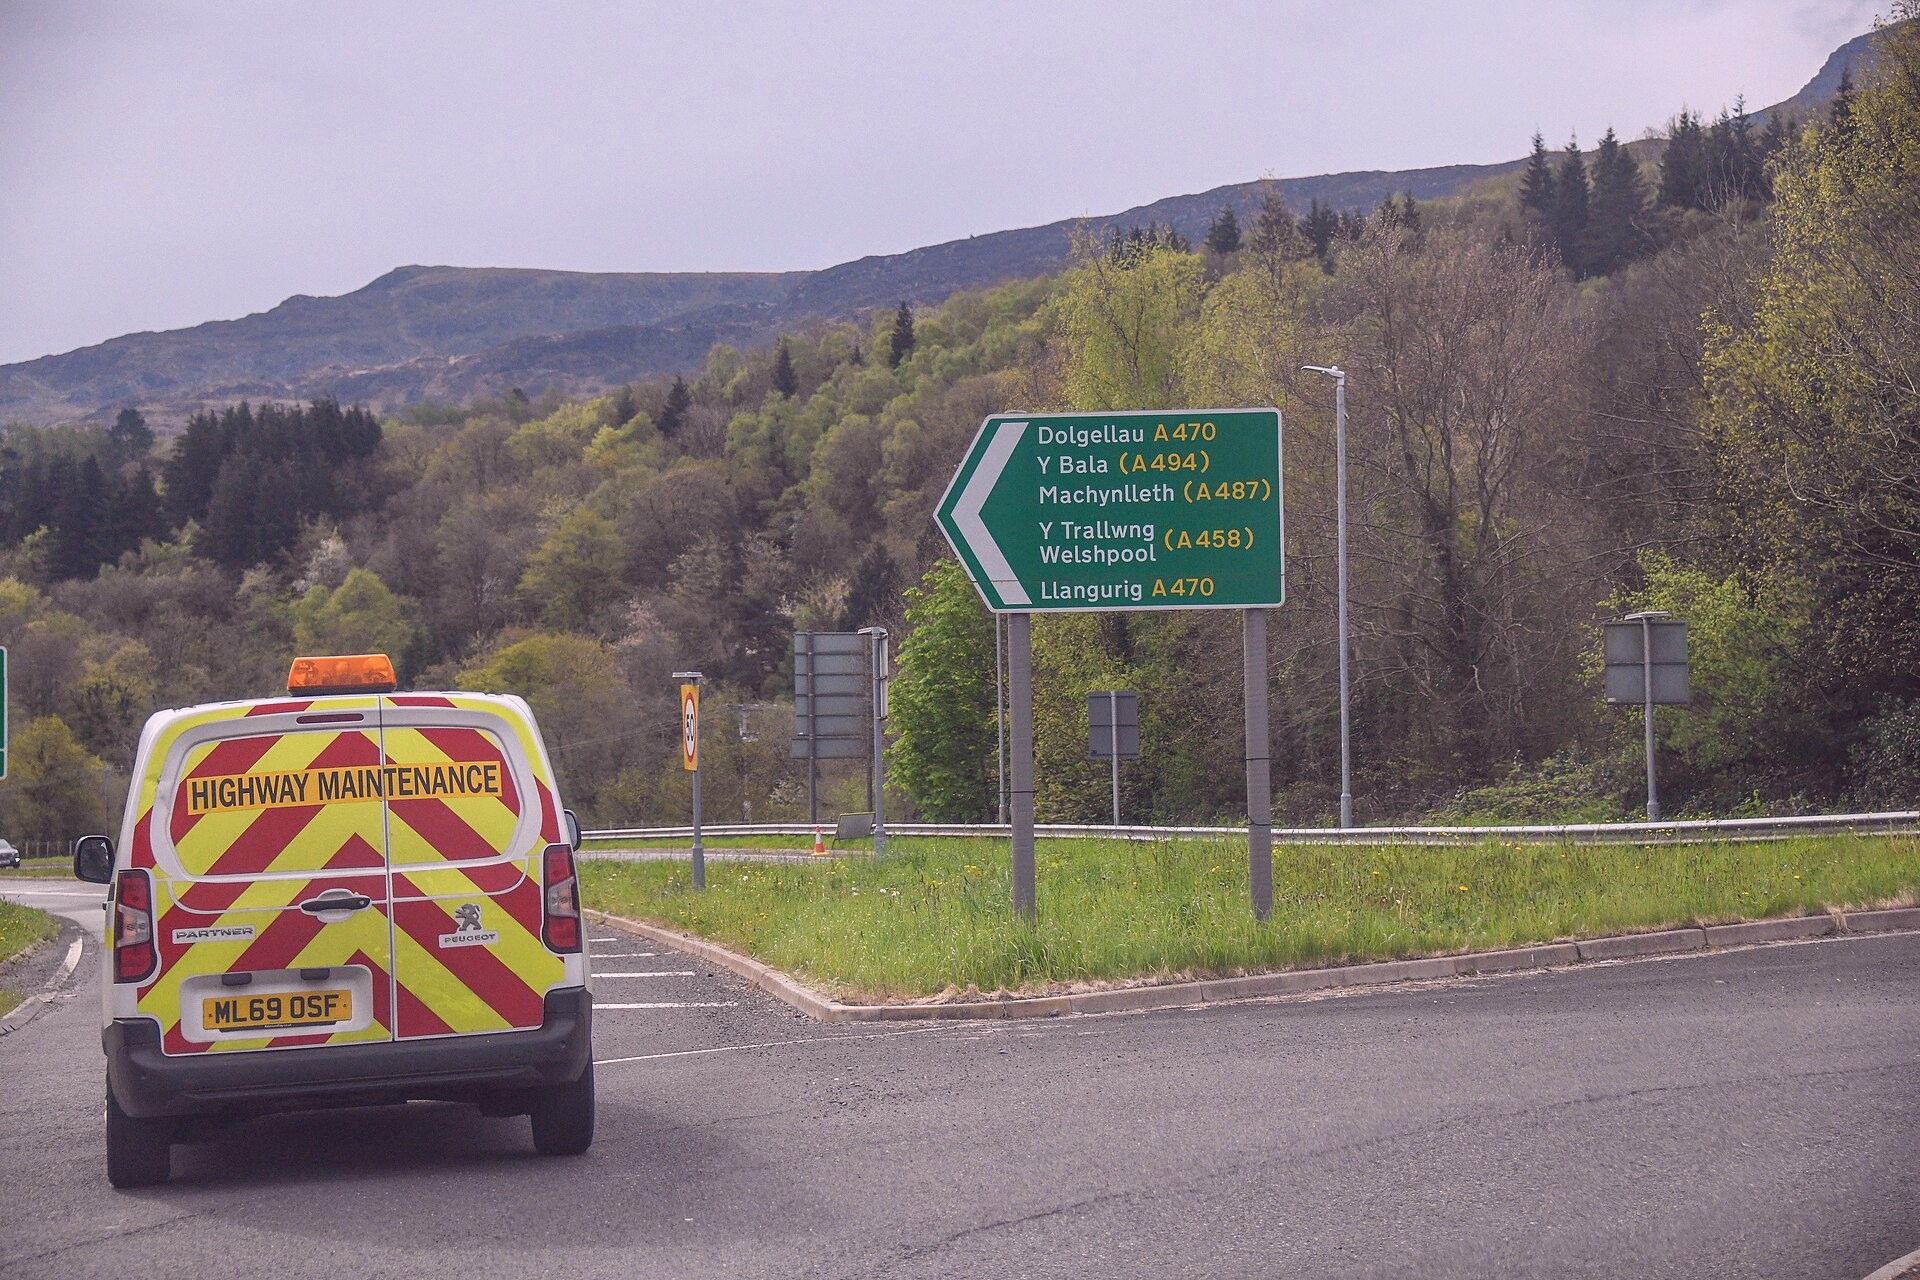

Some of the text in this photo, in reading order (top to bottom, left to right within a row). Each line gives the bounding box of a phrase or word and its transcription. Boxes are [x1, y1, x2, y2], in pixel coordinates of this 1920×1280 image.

[1038, 422, 1217, 447] Dolgellau A470
[1036, 451, 1210, 475] Y Bala (A494)
[1039, 479, 1271, 507] Machynlleth (A487)
[1038, 520, 1155, 542] Y Trallwng
[1164, 527, 1254, 552] (A458)
[1039, 544, 1157, 566] Welshpool
[1041, 577, 1214, 602] Llangurig A470
[192, 764, 499, 810] HIGHWAY MAINTENANCE
[176, 927, 254, 939] PARTNER
[444, 932, 496, 943] PEUGEOT
[215, 994, 339, 1024] ML69 OSF
